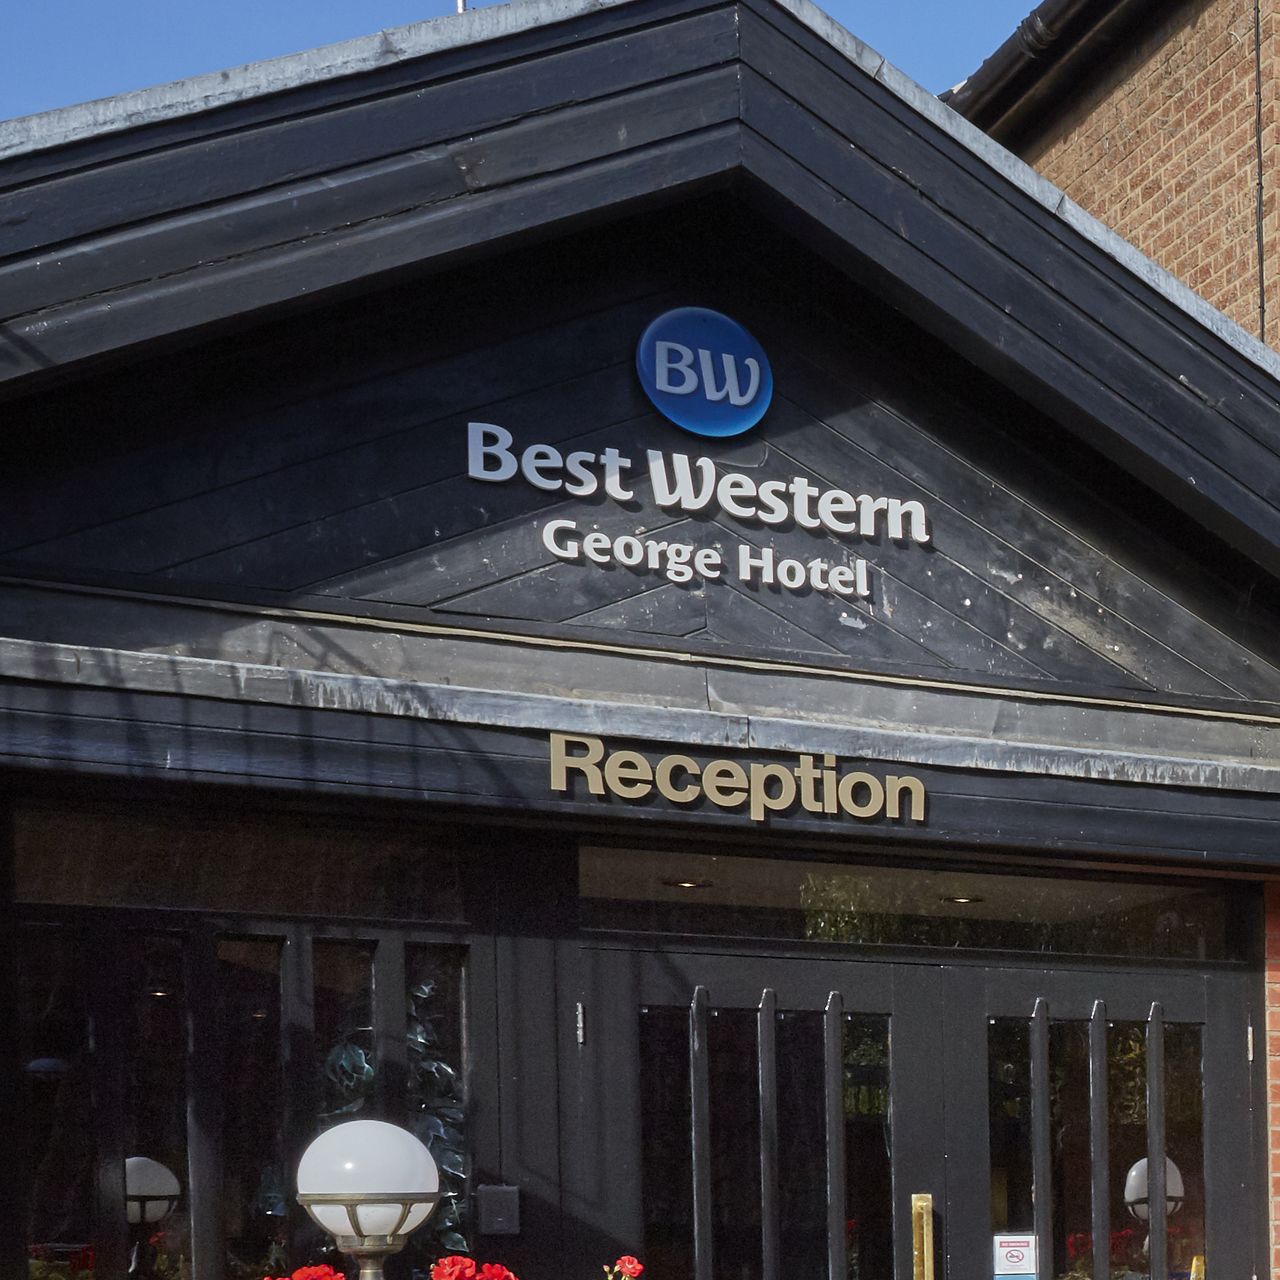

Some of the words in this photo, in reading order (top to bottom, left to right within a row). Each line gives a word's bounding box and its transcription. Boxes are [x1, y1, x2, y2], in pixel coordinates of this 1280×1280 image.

[655, 340, 760, 406] BW
[467, 421, 634, 502] Best
[646, 449, 930, 544] Western
[542, 519, 721, 583] George
[738, 544, 870, 597] Hotel
[550, 732, 925, 821] Reception
